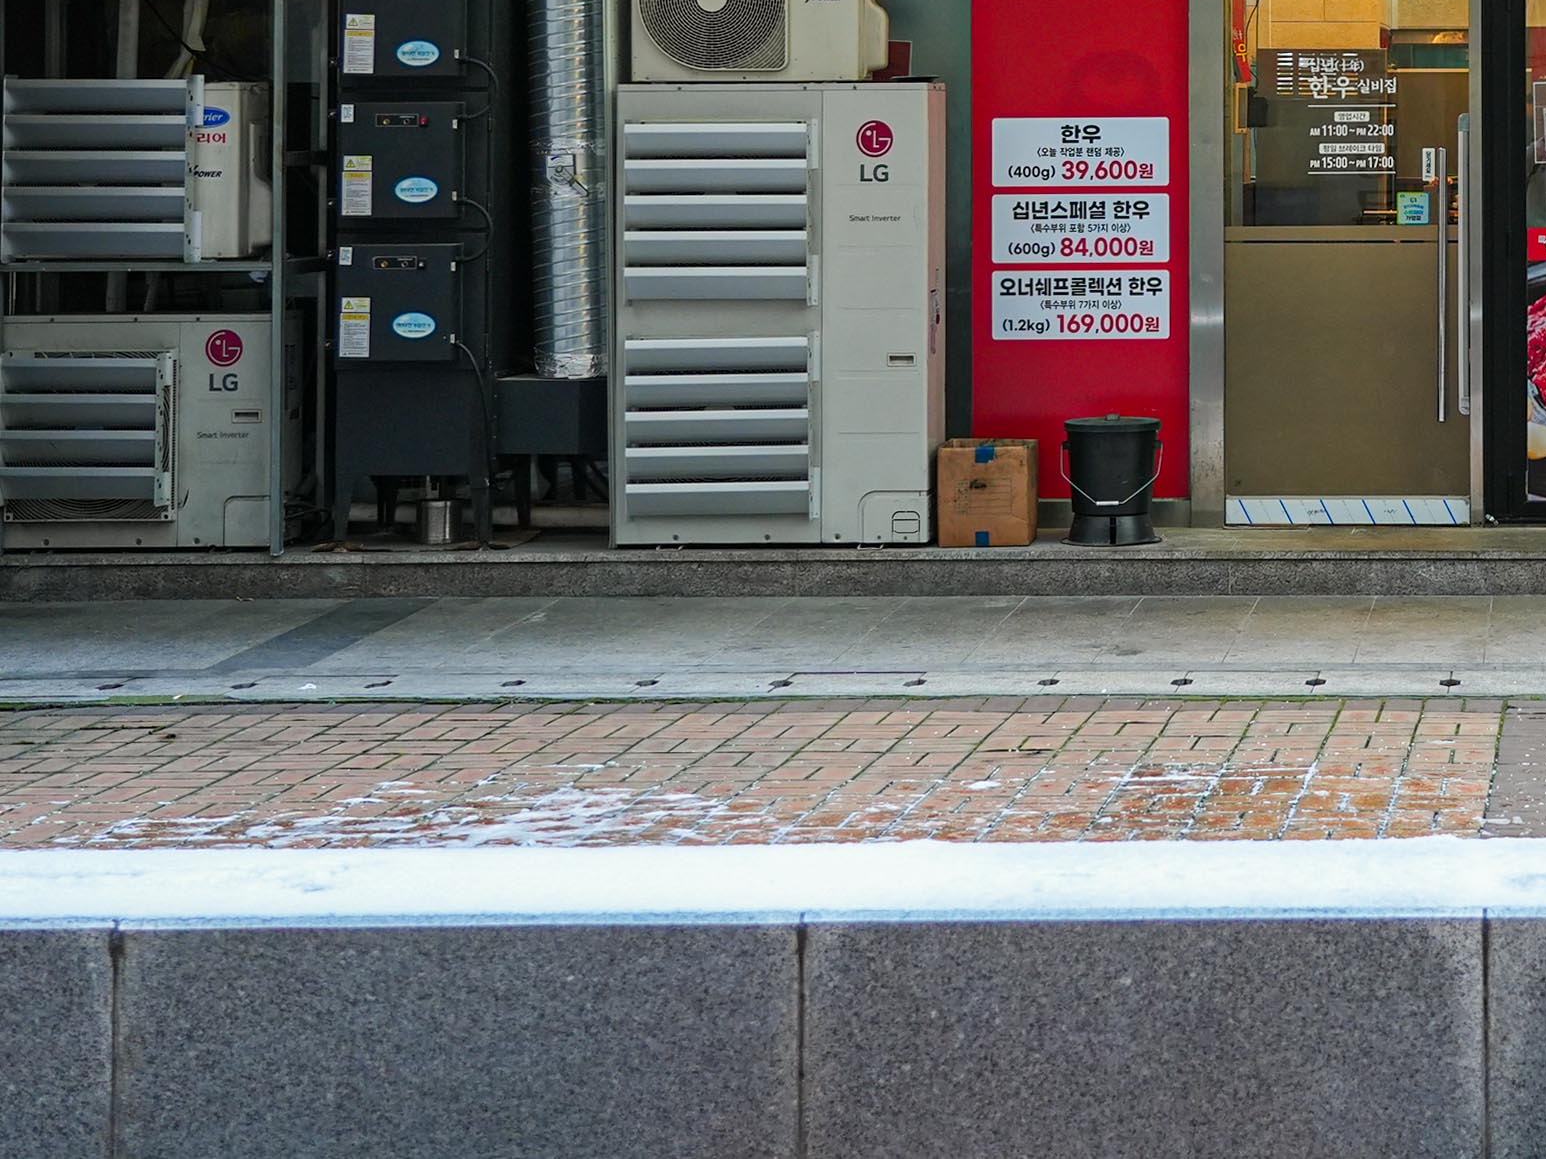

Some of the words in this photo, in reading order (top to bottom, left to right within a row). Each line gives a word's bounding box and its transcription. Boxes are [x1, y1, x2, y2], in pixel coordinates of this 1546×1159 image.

[1307, 75, 1358, 100] 한우
[1358, 77, 1397, 94] 실비집
[1061, 124, 1101, 144] 한우
[1309, 128, 1320, 136] AM
[1321, 124, 1348, 136] 11:00
[1356, 128, 1366, 136] PM
[1367, 124, 1394, 136] 22:00
[1059, 147, 1083, 157] 작업분
[1086, 147, 1102, 157] 랜덤
[1008, 165, 1056, 181] (400g)
[1061, 160, 1154, 181] 39,600원
[1309, 160, 1320, 168] PM
[1321, 156, 1348, 168] 15:00
[1356, 160, 1366, 168] PM
[1367, 156, 1394, 168] 17:00
[860, 164, 889, 182] LG
[849, 214, 869, 222] Smart
[871, 214, 901, 222] Inverter
[1012, 201, 1106, 220] 십년스페셜
[1112, 200, 1150, 220] 한우
[1069, 223, 1085, 233] 포함
[1087, 223, 1109, 233] 5가지
[1008, 242, 1056, 258] (600g)
[1060, 237, 1154, 257] 84,000원
[999, 277, 1122, 296] 오너쉐프콜렉션
[1128, 277, 1163, 296] 한우
[1078, 299, 1100, 309] 7가지
[1002, 318, 1051, 334] (1.2kg)
[1056, 313, 1160, 334] 169,000원
[209, 373, 239, 391] LG
[219, 431, 249, 439] Inverter
